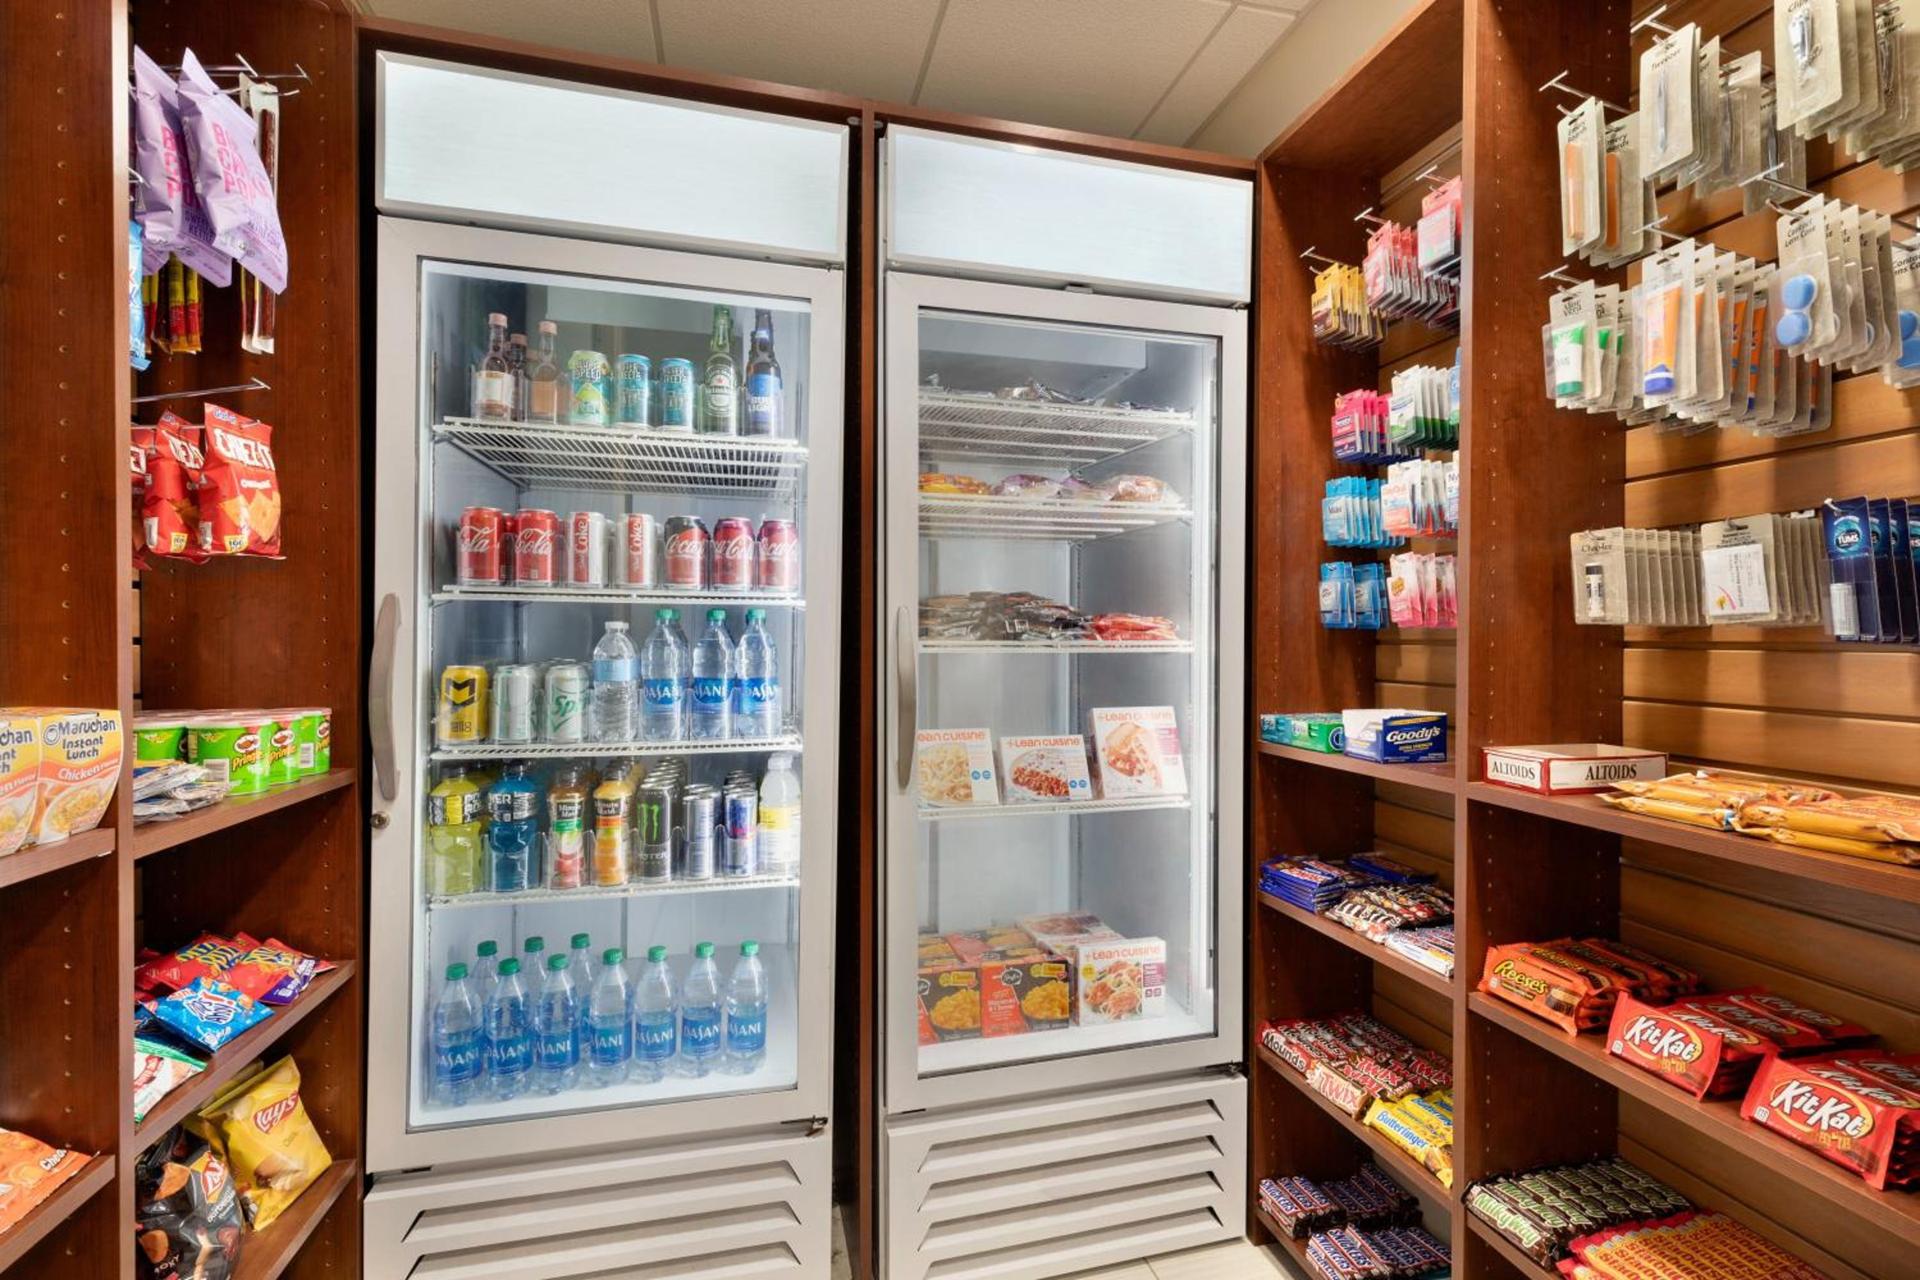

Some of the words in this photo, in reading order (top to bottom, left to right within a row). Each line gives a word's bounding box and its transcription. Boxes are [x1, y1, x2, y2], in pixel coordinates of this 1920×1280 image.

[1836, 531, 1860, 546] TUMS
[58, 718, 116, 736] Maruchan
[1385, 725, 1441, 744] Goody's
[62, 736, 103, 750] Instant
[66, 748, 99, 760] Lunch
[58, 763, 100, 781] Chicken
[1491, 761, 1536, 780] ALTOIDS
[1585, 763, 1638, 781] ALTOIDS
[1493, 959, 1549, 995] Reese's
[1263, 1032, 1307, 1072] Mounds
[1320, 1069, 1359, 1111] TWIX
[1376, 1110, 1429, 1149] Butterfinger
